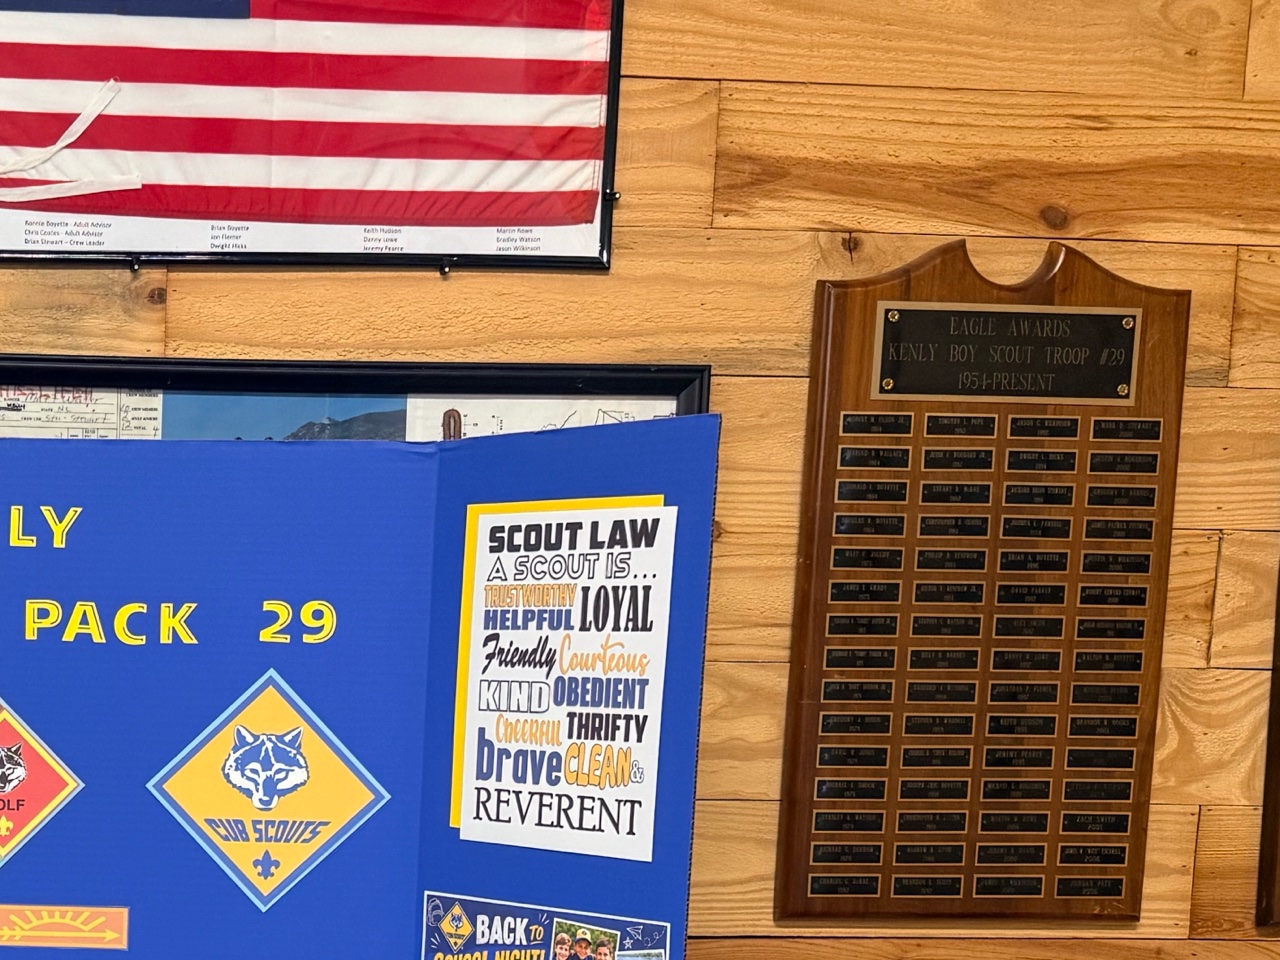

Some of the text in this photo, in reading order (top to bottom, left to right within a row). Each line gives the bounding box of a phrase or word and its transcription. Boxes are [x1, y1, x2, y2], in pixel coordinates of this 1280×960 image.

[950, 317, 1071, 338] EAGLE AWARDS
[888, 343, 1125, 366] KENLY BOY SCOUT TROOP #29
[958, 372, 1055, 392] 1954-PRESENT
[488, 518, 660, 553] SCOUT LAW
[487, 556, 507, 582] A
[514, 553, 600, 581] SCOUT
[24, 599, 338, 646] PACK 29
[483, 608, 575, 631] HELPFUL
[484, 583, 653, 632] TRUSTWORTHY LOYAL
[481, 633, 651, 678] Friendly Courteous
[478, 676, 649, 714] KIND OBEDIENT
[566, 711, 648, 743] THRIFTY
[475, 727, 645, 790] brave CLEAN &
[472, 787, 642, 836] REVERENT
[204, 818, 331, 845] CUB SCOUTS
[476, 915, 544, 945] BACK TO
